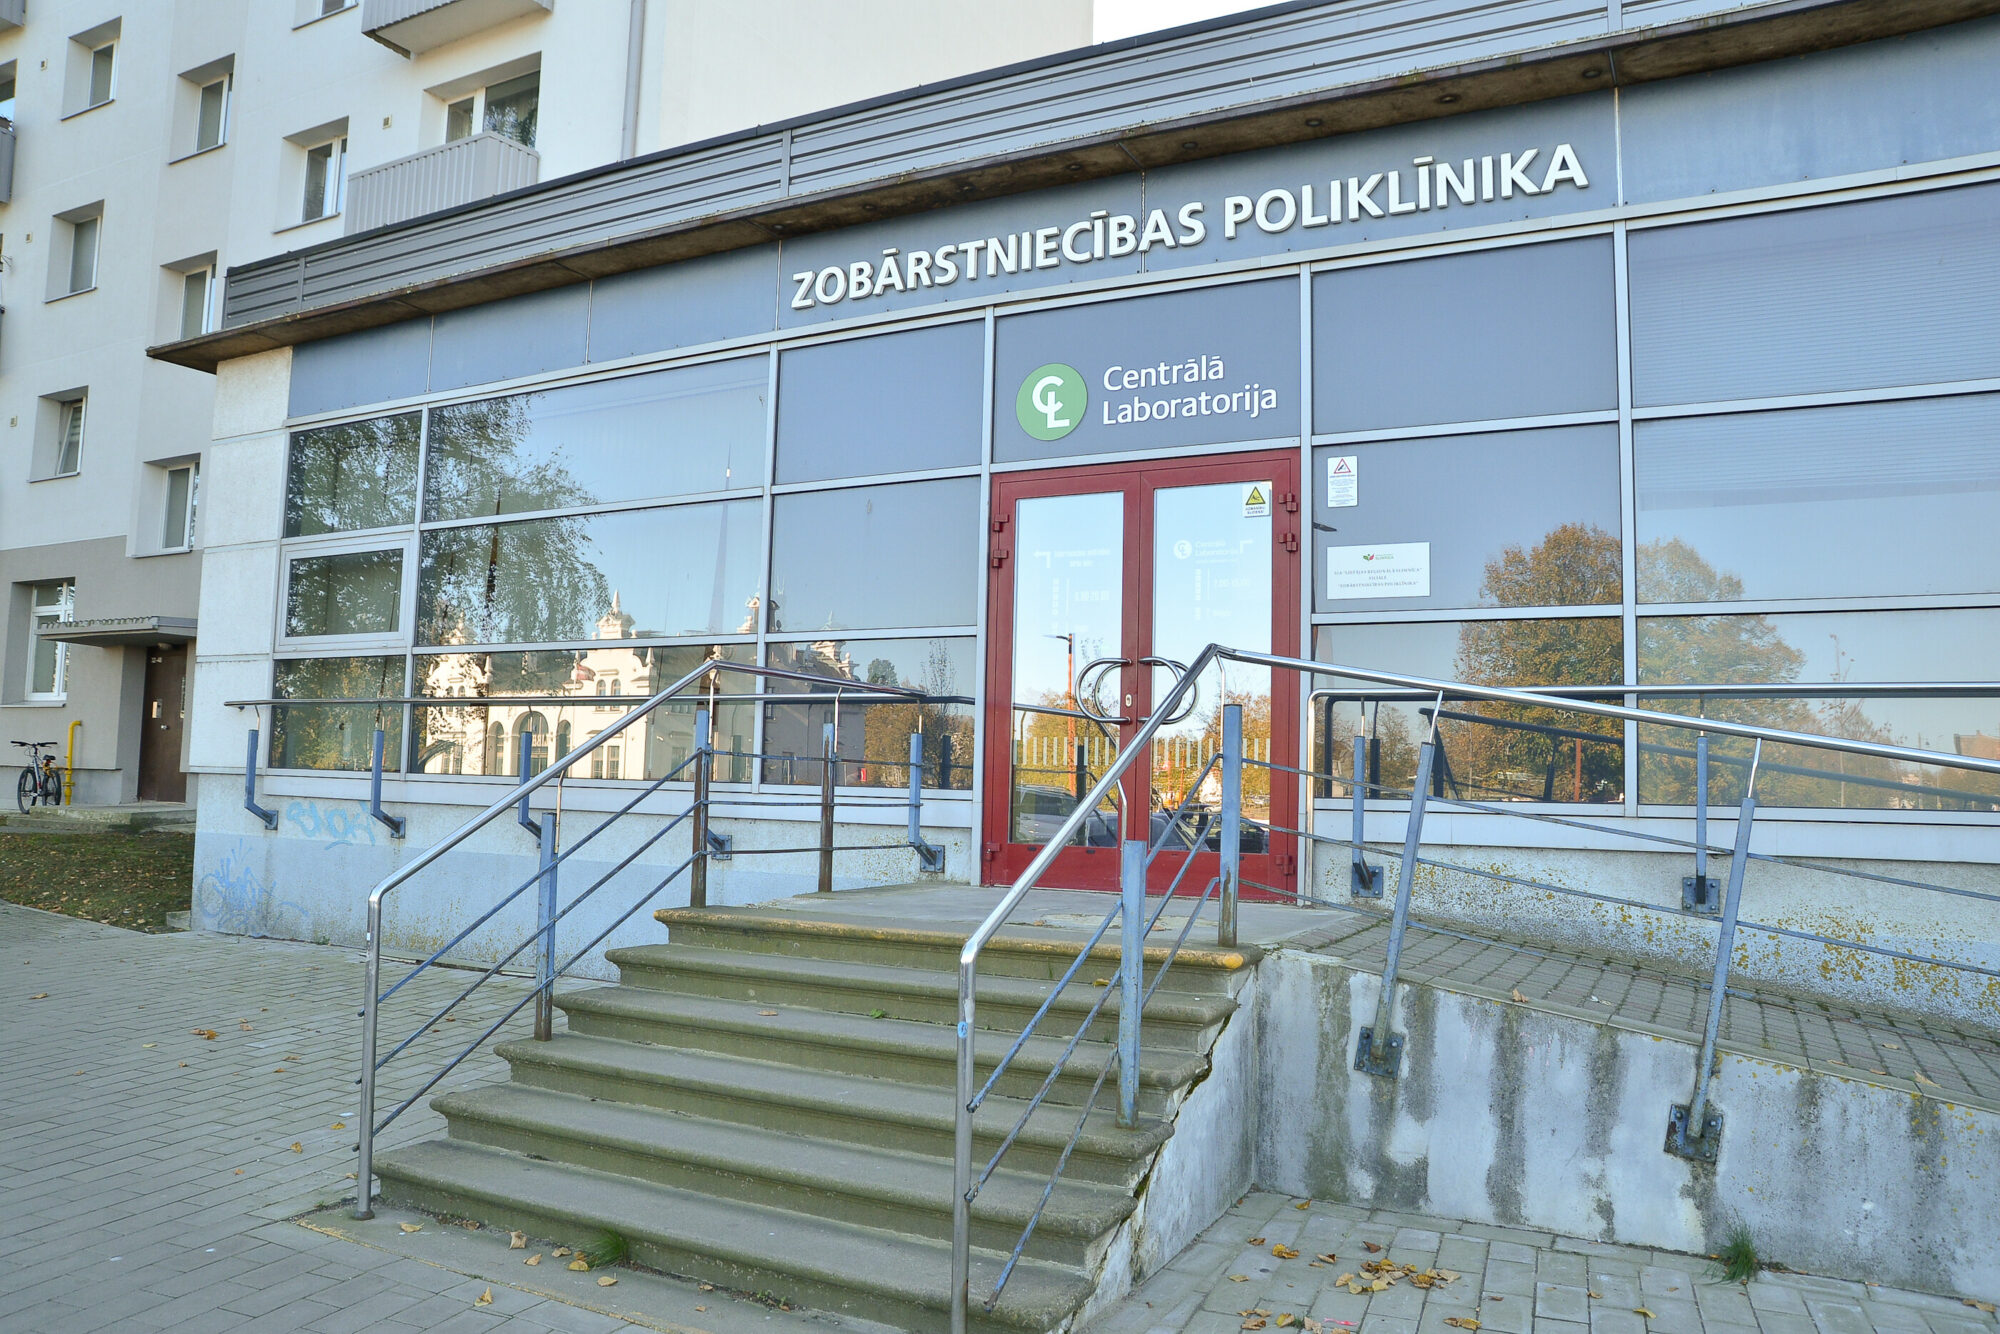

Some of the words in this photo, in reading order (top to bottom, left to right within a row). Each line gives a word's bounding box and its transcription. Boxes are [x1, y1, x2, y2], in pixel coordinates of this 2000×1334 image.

[791, 202, 1207, 310] ZOBĀRSTNIECĪBAS
[1224, 143, 1589, 240] POLIKLĪNIKA
[1103, 354, 1225, 392] Centrālā
[1103, 383, 1278, 425] Laboratorija
